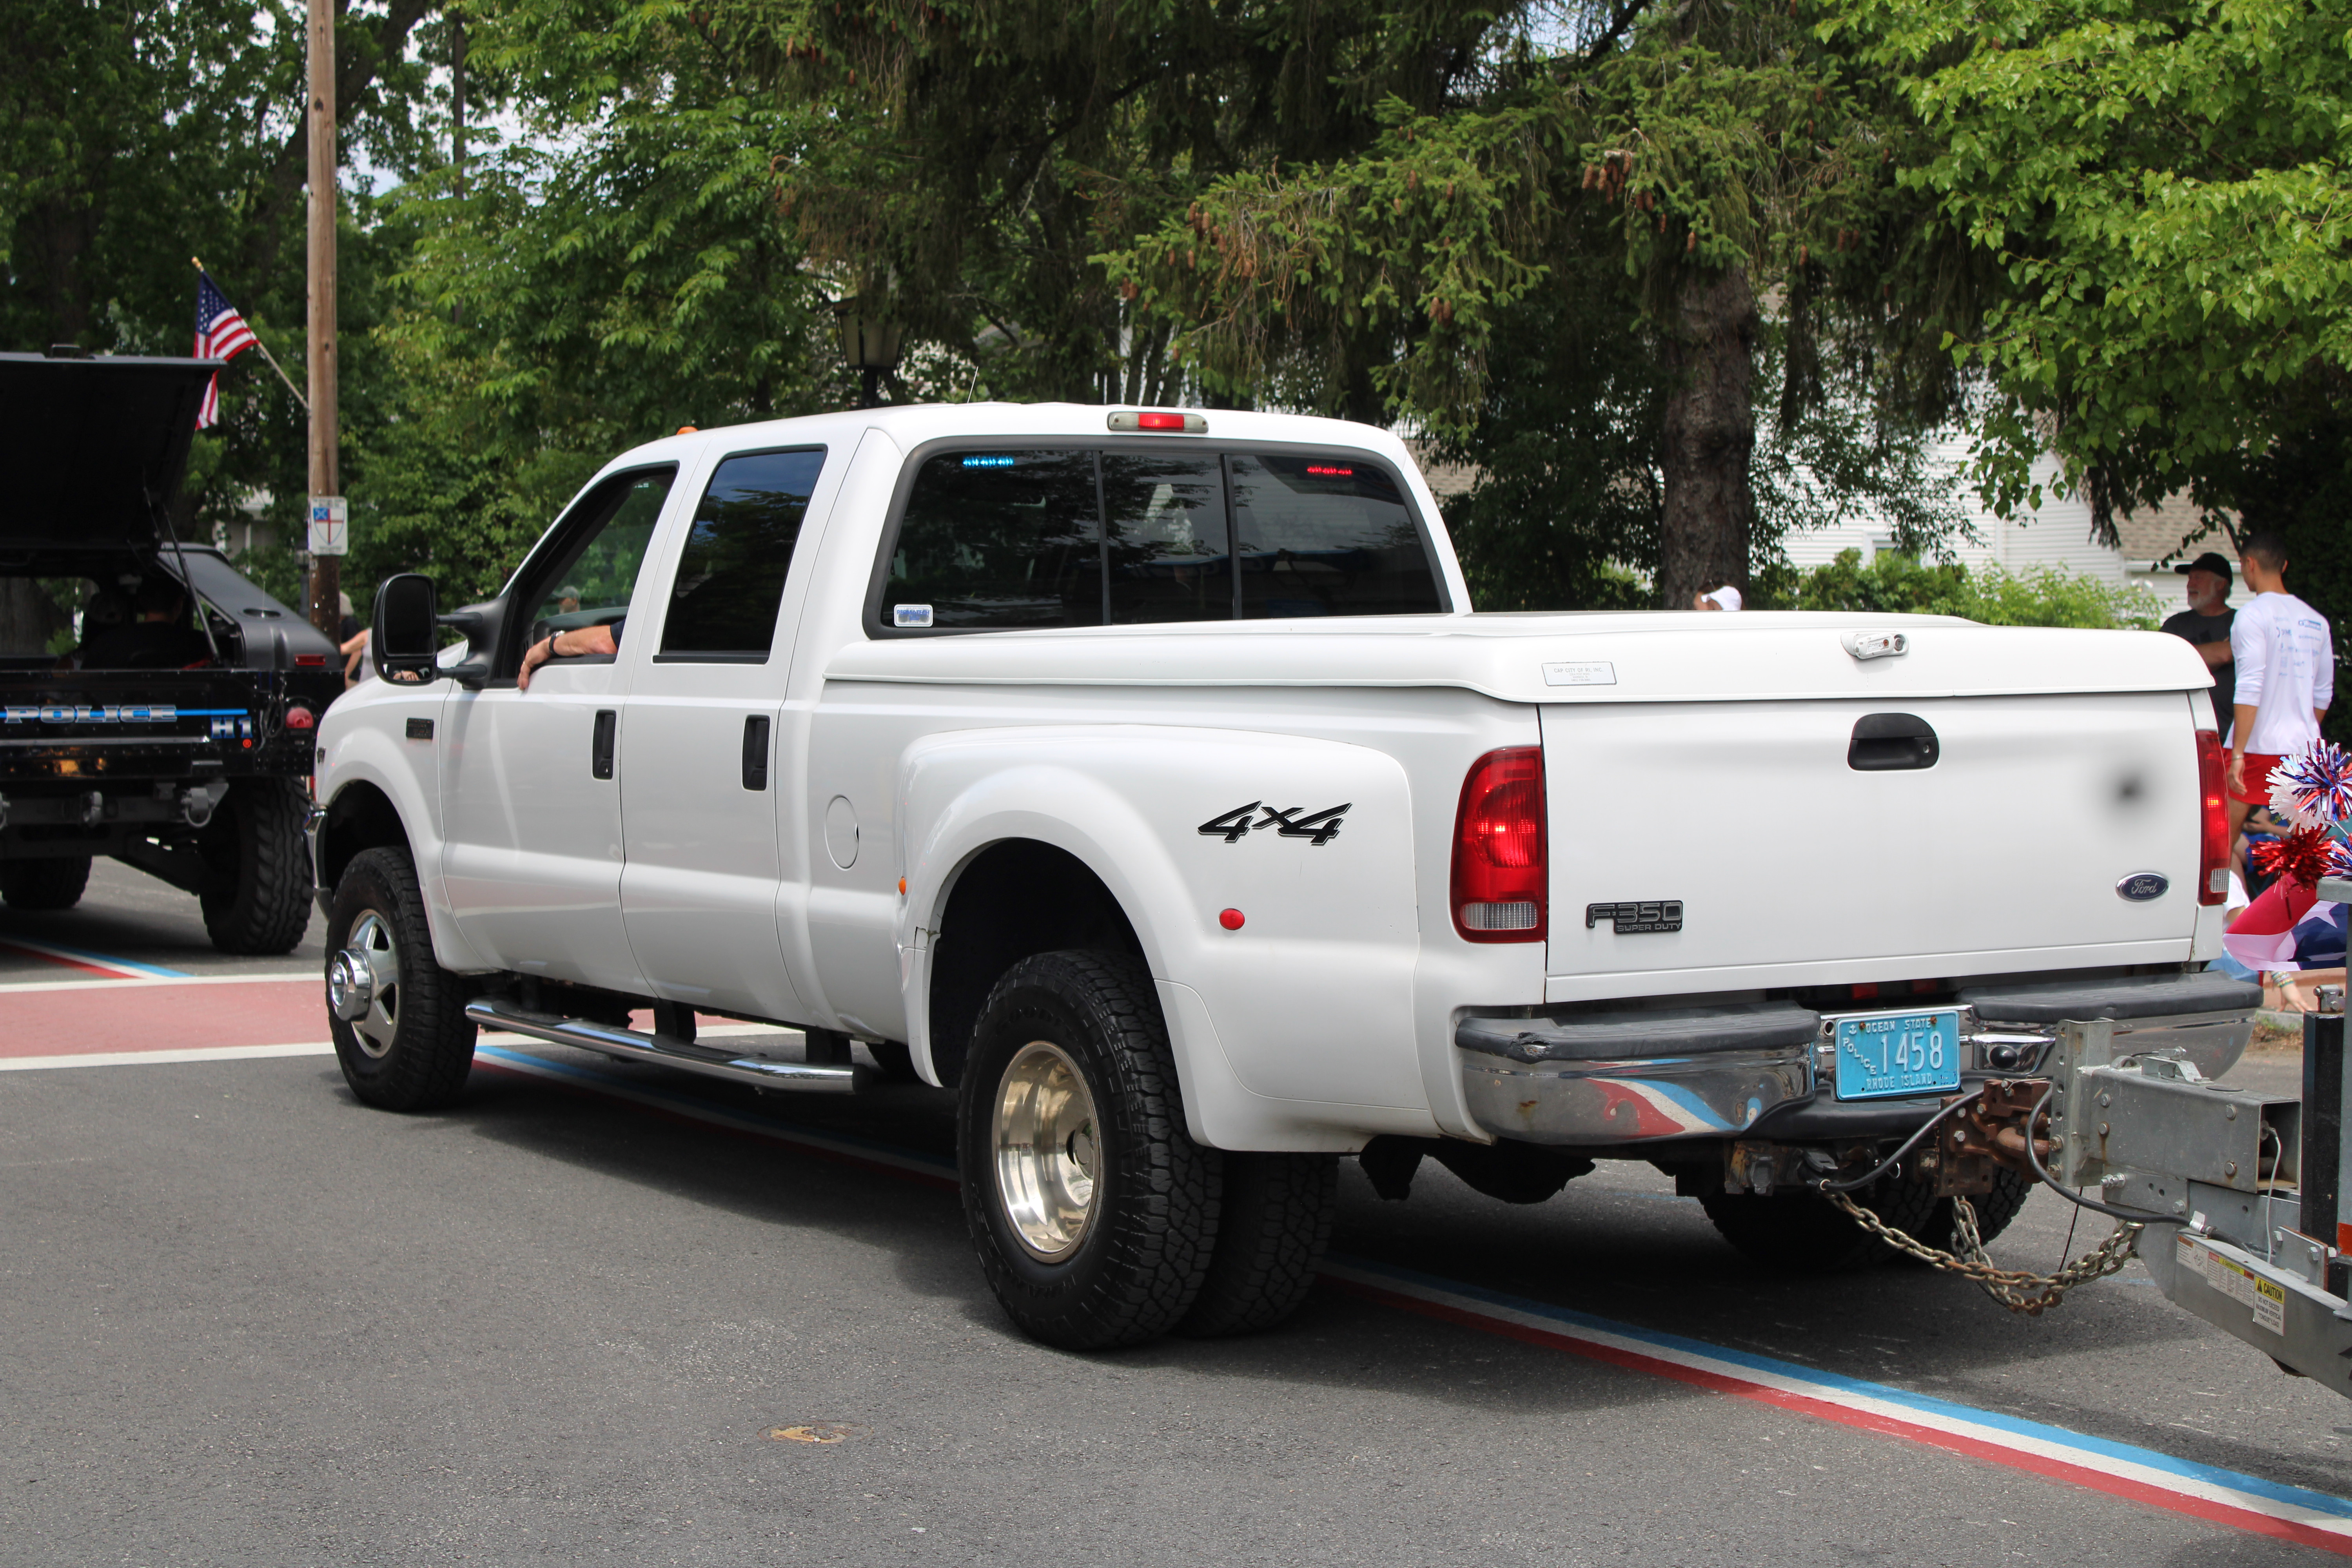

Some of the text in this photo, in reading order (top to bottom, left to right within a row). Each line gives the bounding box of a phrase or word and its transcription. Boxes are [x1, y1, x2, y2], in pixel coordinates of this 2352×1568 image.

[5, 704, 178, 724] POLICE
[2131, 879, 2158, 894] Ford
[1866, 1019, 1932, 1034] OCEAN STATE
[1843, 1037, 1877, 1076] POLICE
[1881, 1031, 1943, 1074] 1458
[1866, 1076, 1895, 1091] RHODE
[1901, 1073, 1933, 1088] ISLAND
[2264, 1283, 2282, 1301] CAUTION
[2256, 1303, 2282, 1321] MAXIMUM VERTICAL
[2269, 1302, 2279, 1312] EXCEED
